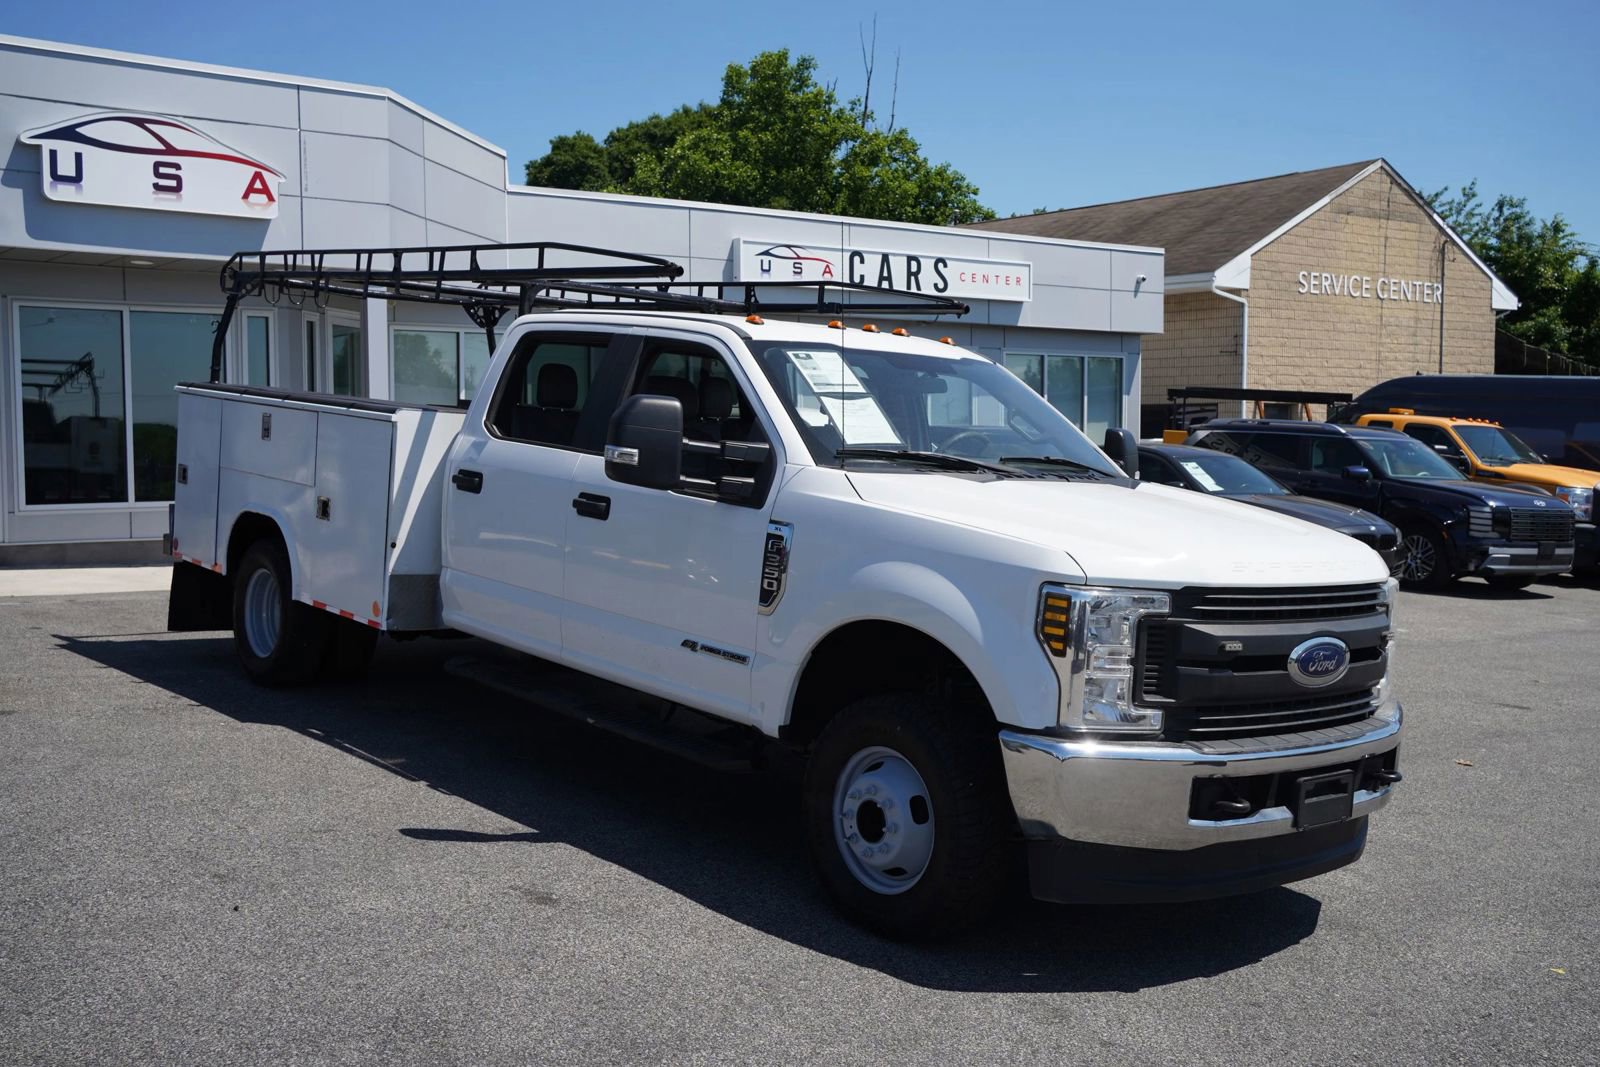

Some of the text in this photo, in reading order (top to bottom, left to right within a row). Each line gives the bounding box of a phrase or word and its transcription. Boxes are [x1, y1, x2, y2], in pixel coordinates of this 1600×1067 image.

[49, 149, 276, 202] USA
[759, 258, 833, 277] USA
[849, 250, 1022, 293] CARS CENTER
[1298, 270, 1443, 303] SERVICE CENTER
[1309, 651, 1338, 671] Ford
